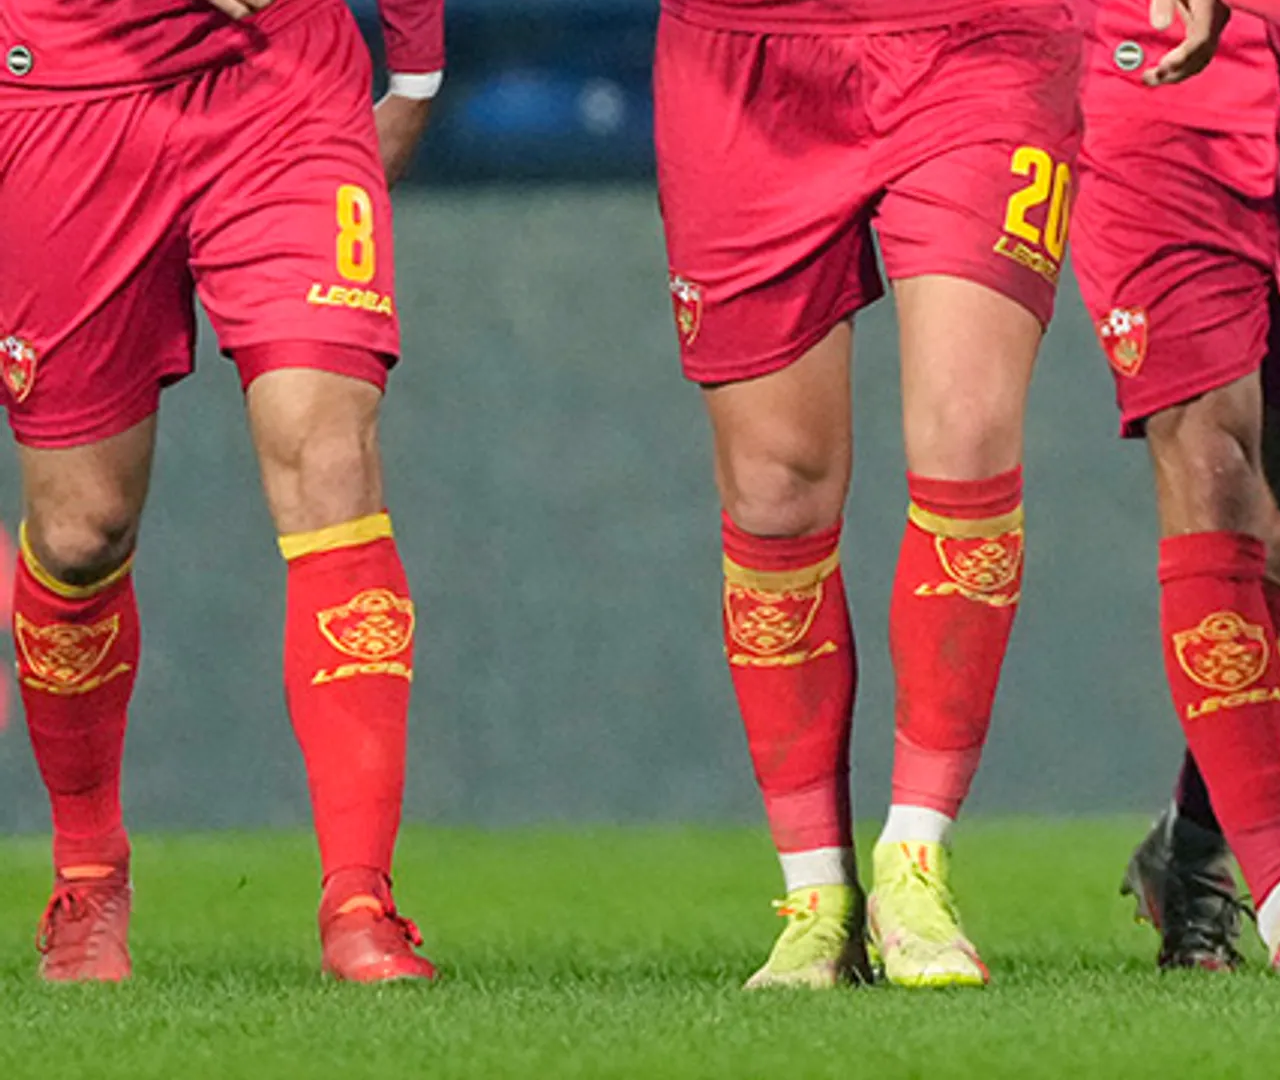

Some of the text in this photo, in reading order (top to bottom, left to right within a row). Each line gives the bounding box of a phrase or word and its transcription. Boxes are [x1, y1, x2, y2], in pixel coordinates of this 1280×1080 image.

[335, 184, 375, 284] 8
[1004, 146, 1070, 262] 20
[307, 283, 393, 315] LEGEA
